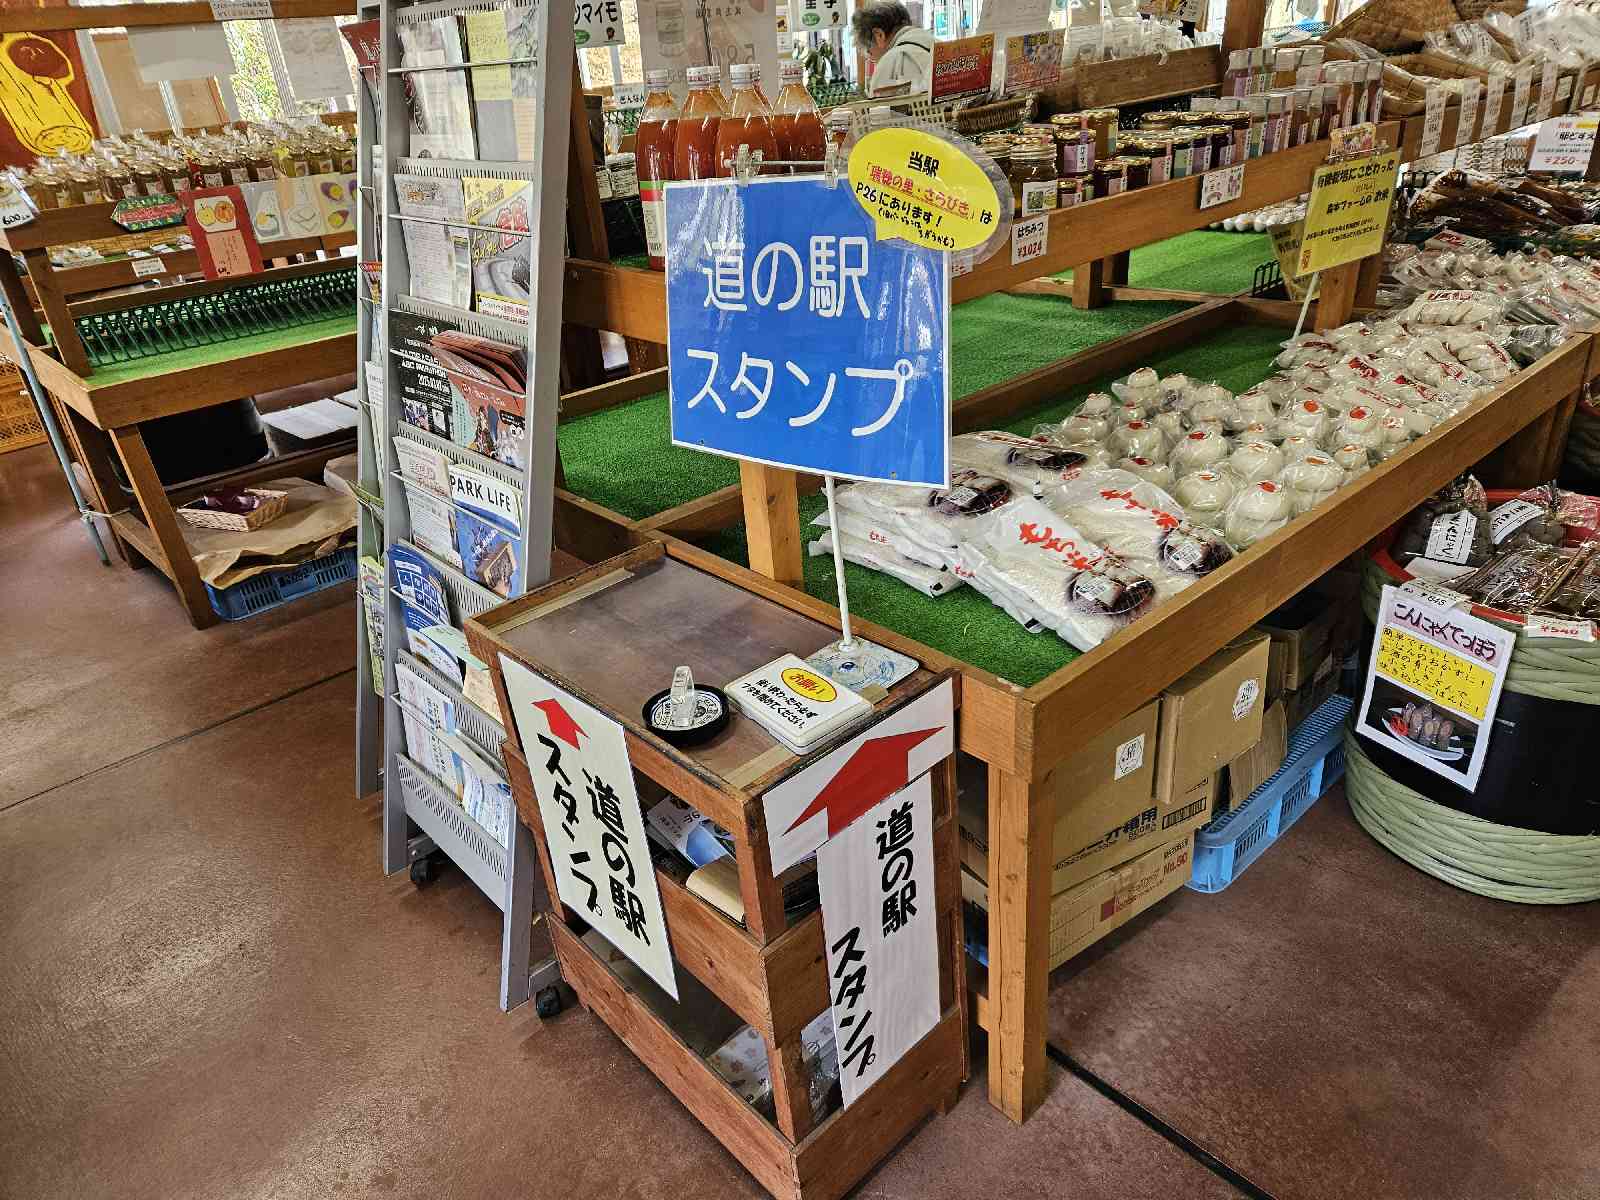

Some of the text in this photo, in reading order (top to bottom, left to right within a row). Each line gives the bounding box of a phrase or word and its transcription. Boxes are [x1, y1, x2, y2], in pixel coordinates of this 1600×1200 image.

[907, 151, 940, 177] 当駅
[1017, 221, 1044, 238] はちみつ
[702, 235, 872, 319] 道の駅
[687, 348, 914, 438] スタンプ
[450, 476, 483, 502] PARK
[486, 488, 512, 513] LIFE
[1393, 602, 1497, 662] こんにゃくてっぽう
[789, 672, 823, 696] お願い
[536, 732, 603, 916] スタンプ
[582, 767, 651, 946] 道の駅
[876, 801, 918, 938] 道の駅
[831, 926, 877, 1078] スタンプ
